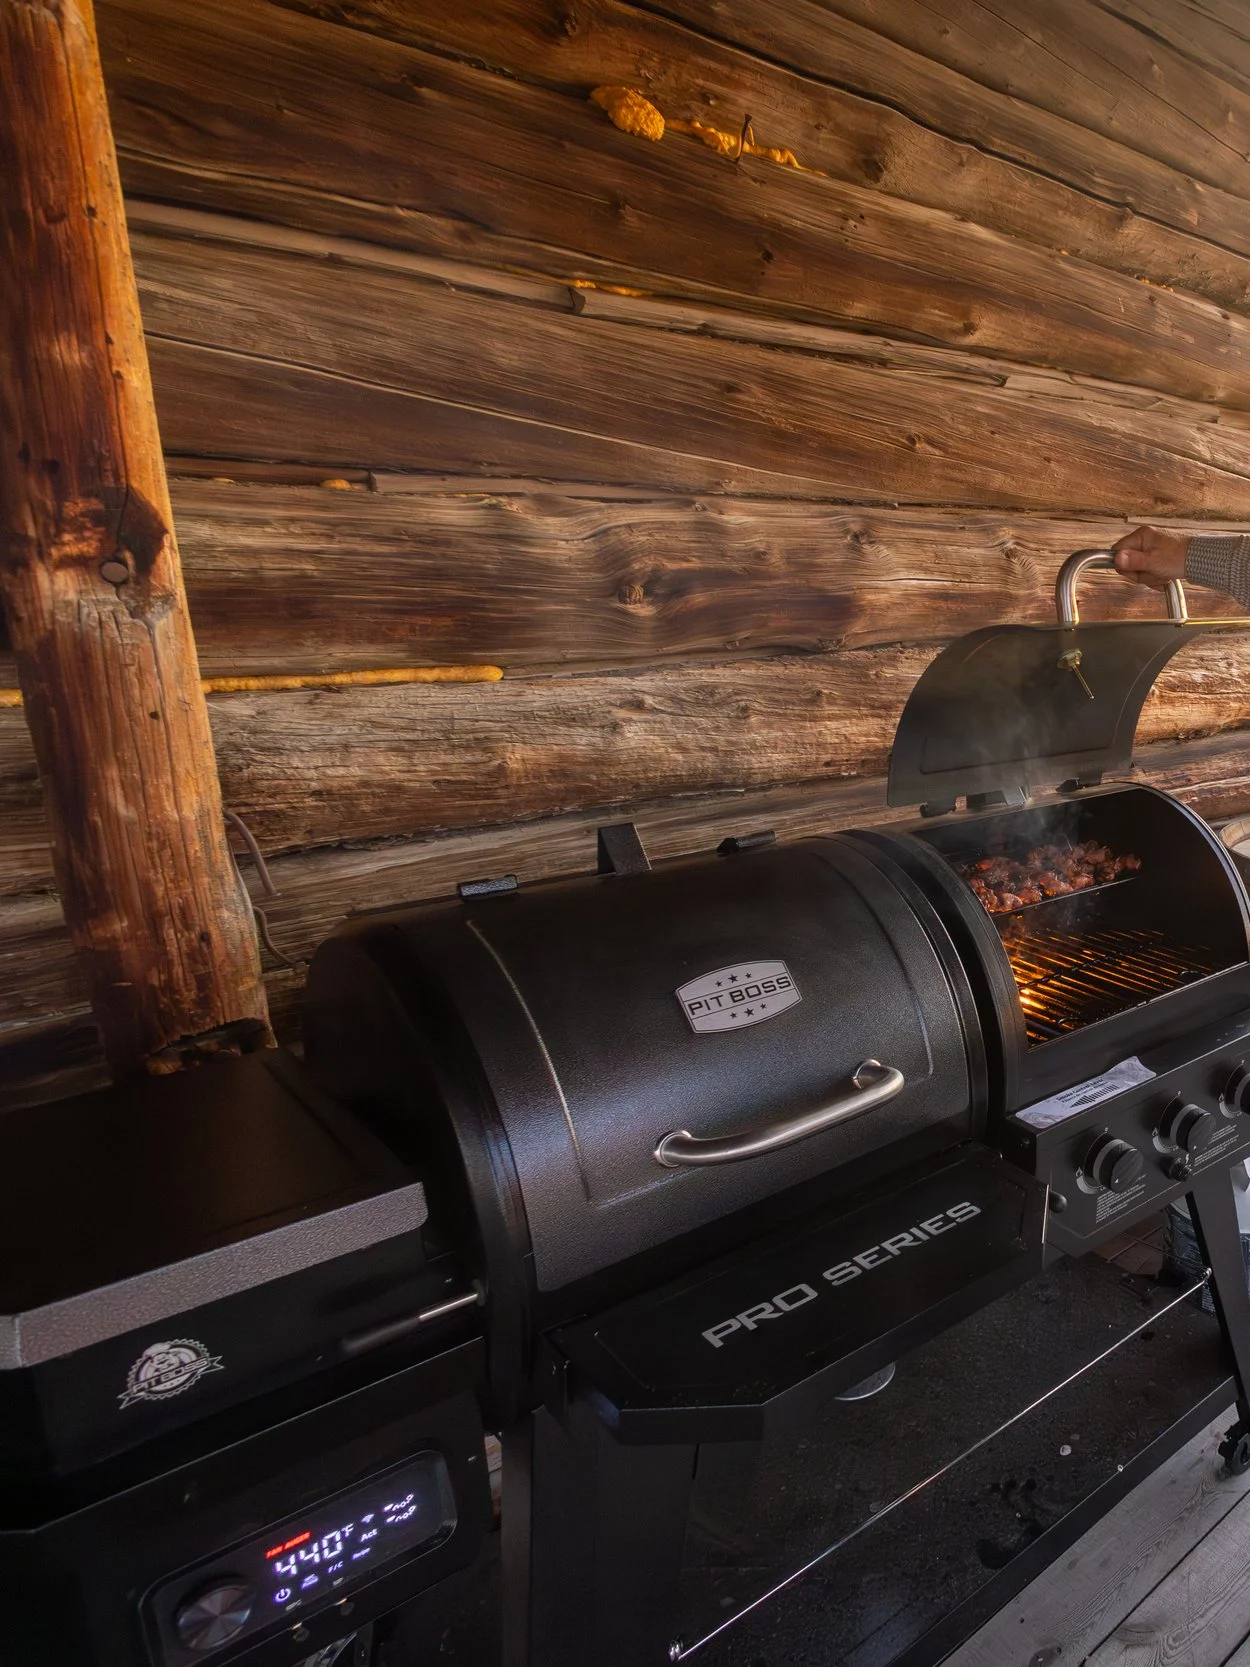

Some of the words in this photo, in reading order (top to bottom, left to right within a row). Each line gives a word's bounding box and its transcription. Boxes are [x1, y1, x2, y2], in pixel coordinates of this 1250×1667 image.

[688, 995, 724, 1016] PIT
[729, 976, 792, 1003] BOSS
[701, 1283, 818, 1348] PRO
[822, 1201, 982, 1286] SERIES
